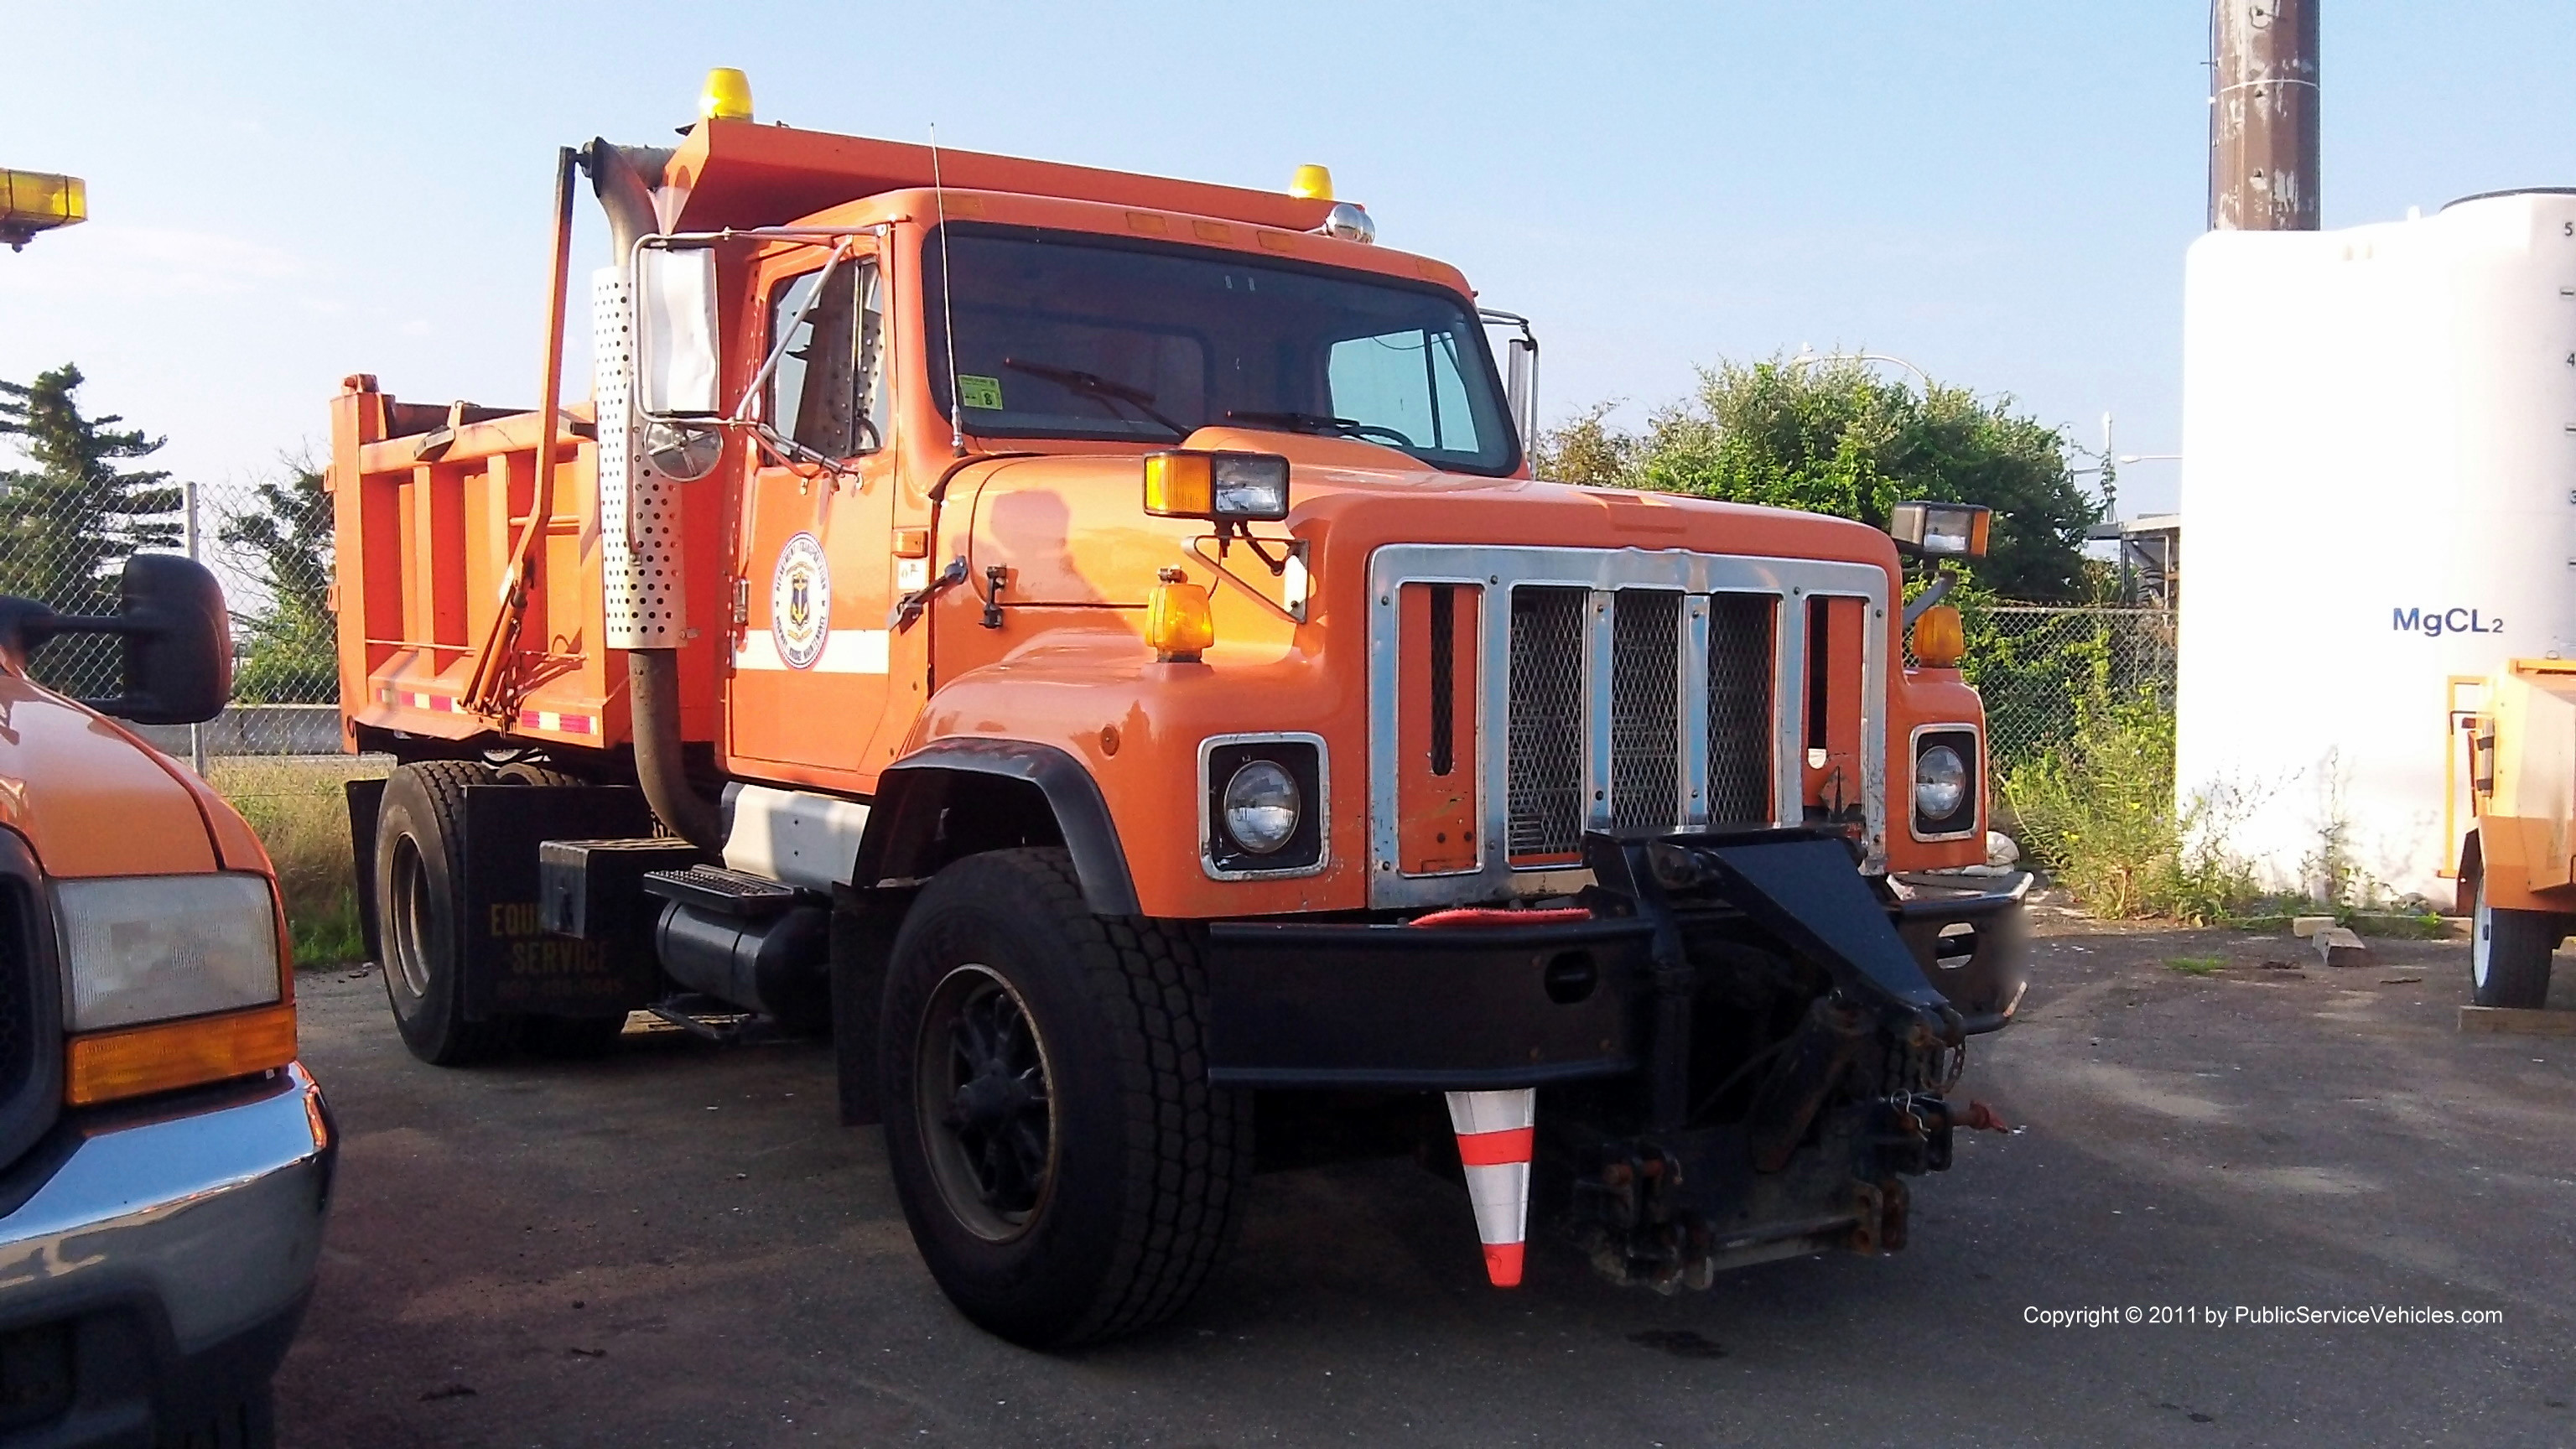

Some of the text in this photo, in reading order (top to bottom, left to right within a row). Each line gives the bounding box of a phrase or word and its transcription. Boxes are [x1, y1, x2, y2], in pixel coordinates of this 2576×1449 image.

[2564, 221, 2573, 236] 5
[2567, 352, 2575, 367] 4
[512, 940, 610, 974] SERVICE
